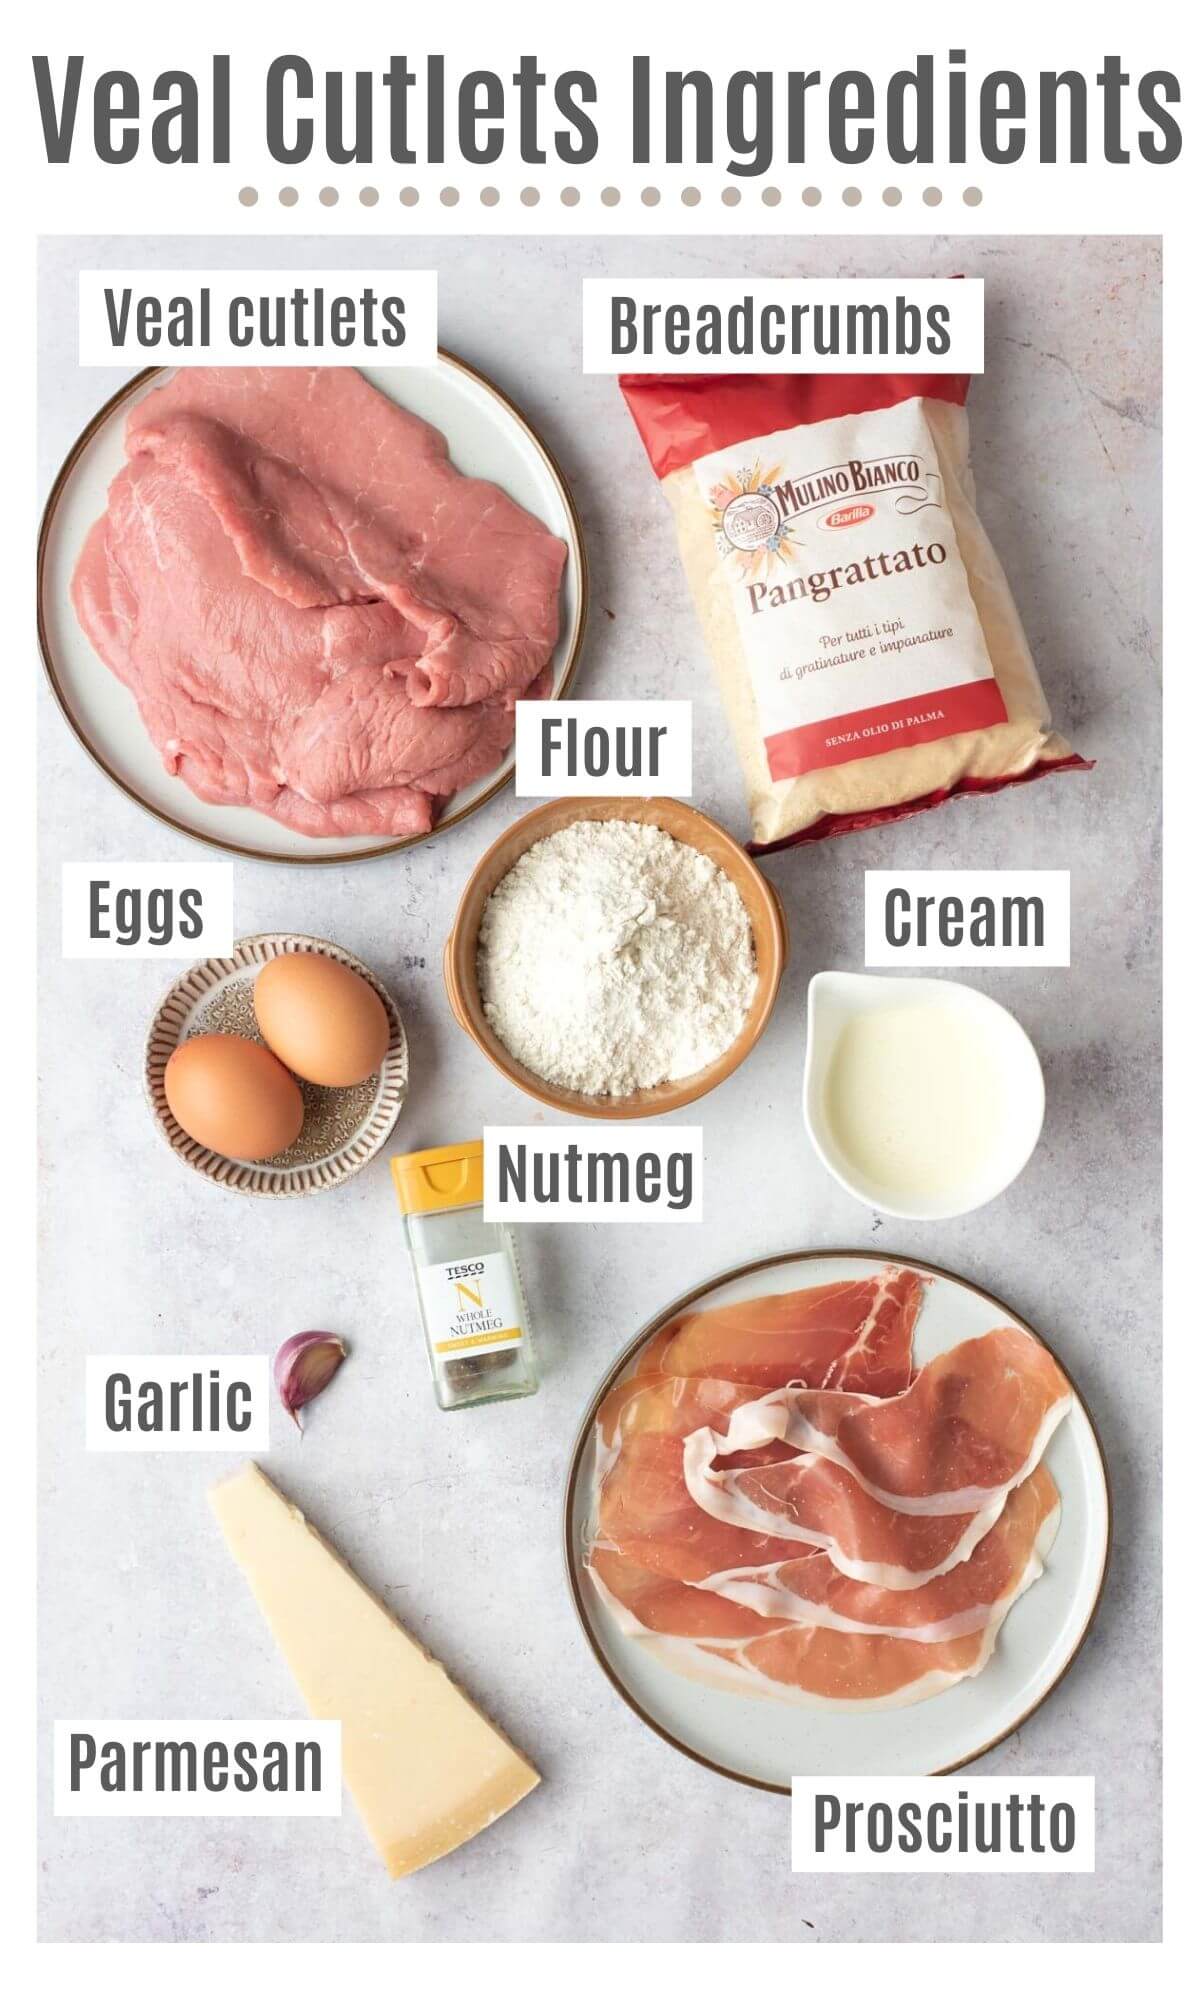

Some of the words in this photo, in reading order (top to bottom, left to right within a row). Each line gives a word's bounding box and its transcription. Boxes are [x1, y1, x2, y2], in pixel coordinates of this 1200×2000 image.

[831, 507, 870, 526] Barilla
[746, 543, 946, 615] Pangrattato
[819, 634, 843, 649] Per
[846, 625, 872, 643] tutti
[882, 618, 905, 634] tipi
[780, 667, 793, 680] di
[796, 648, 866, 680] gratinature
[869, 647, 877, 656] e
[879, 627, 954, 654] impanature
[825, 732, 860, 747] SENZA
[862, 724, 889, 737] OLIO
[891, 720, 905, 730] DI
[907, 710, 945, 726] PALMA
[445, 1262, 485, 1277] TESCO
[454, 1280, 483, 1312] N
[449, 1317, 503, 1336] NUTMEG
[456, 1309, 492, 1322] WHOLE
